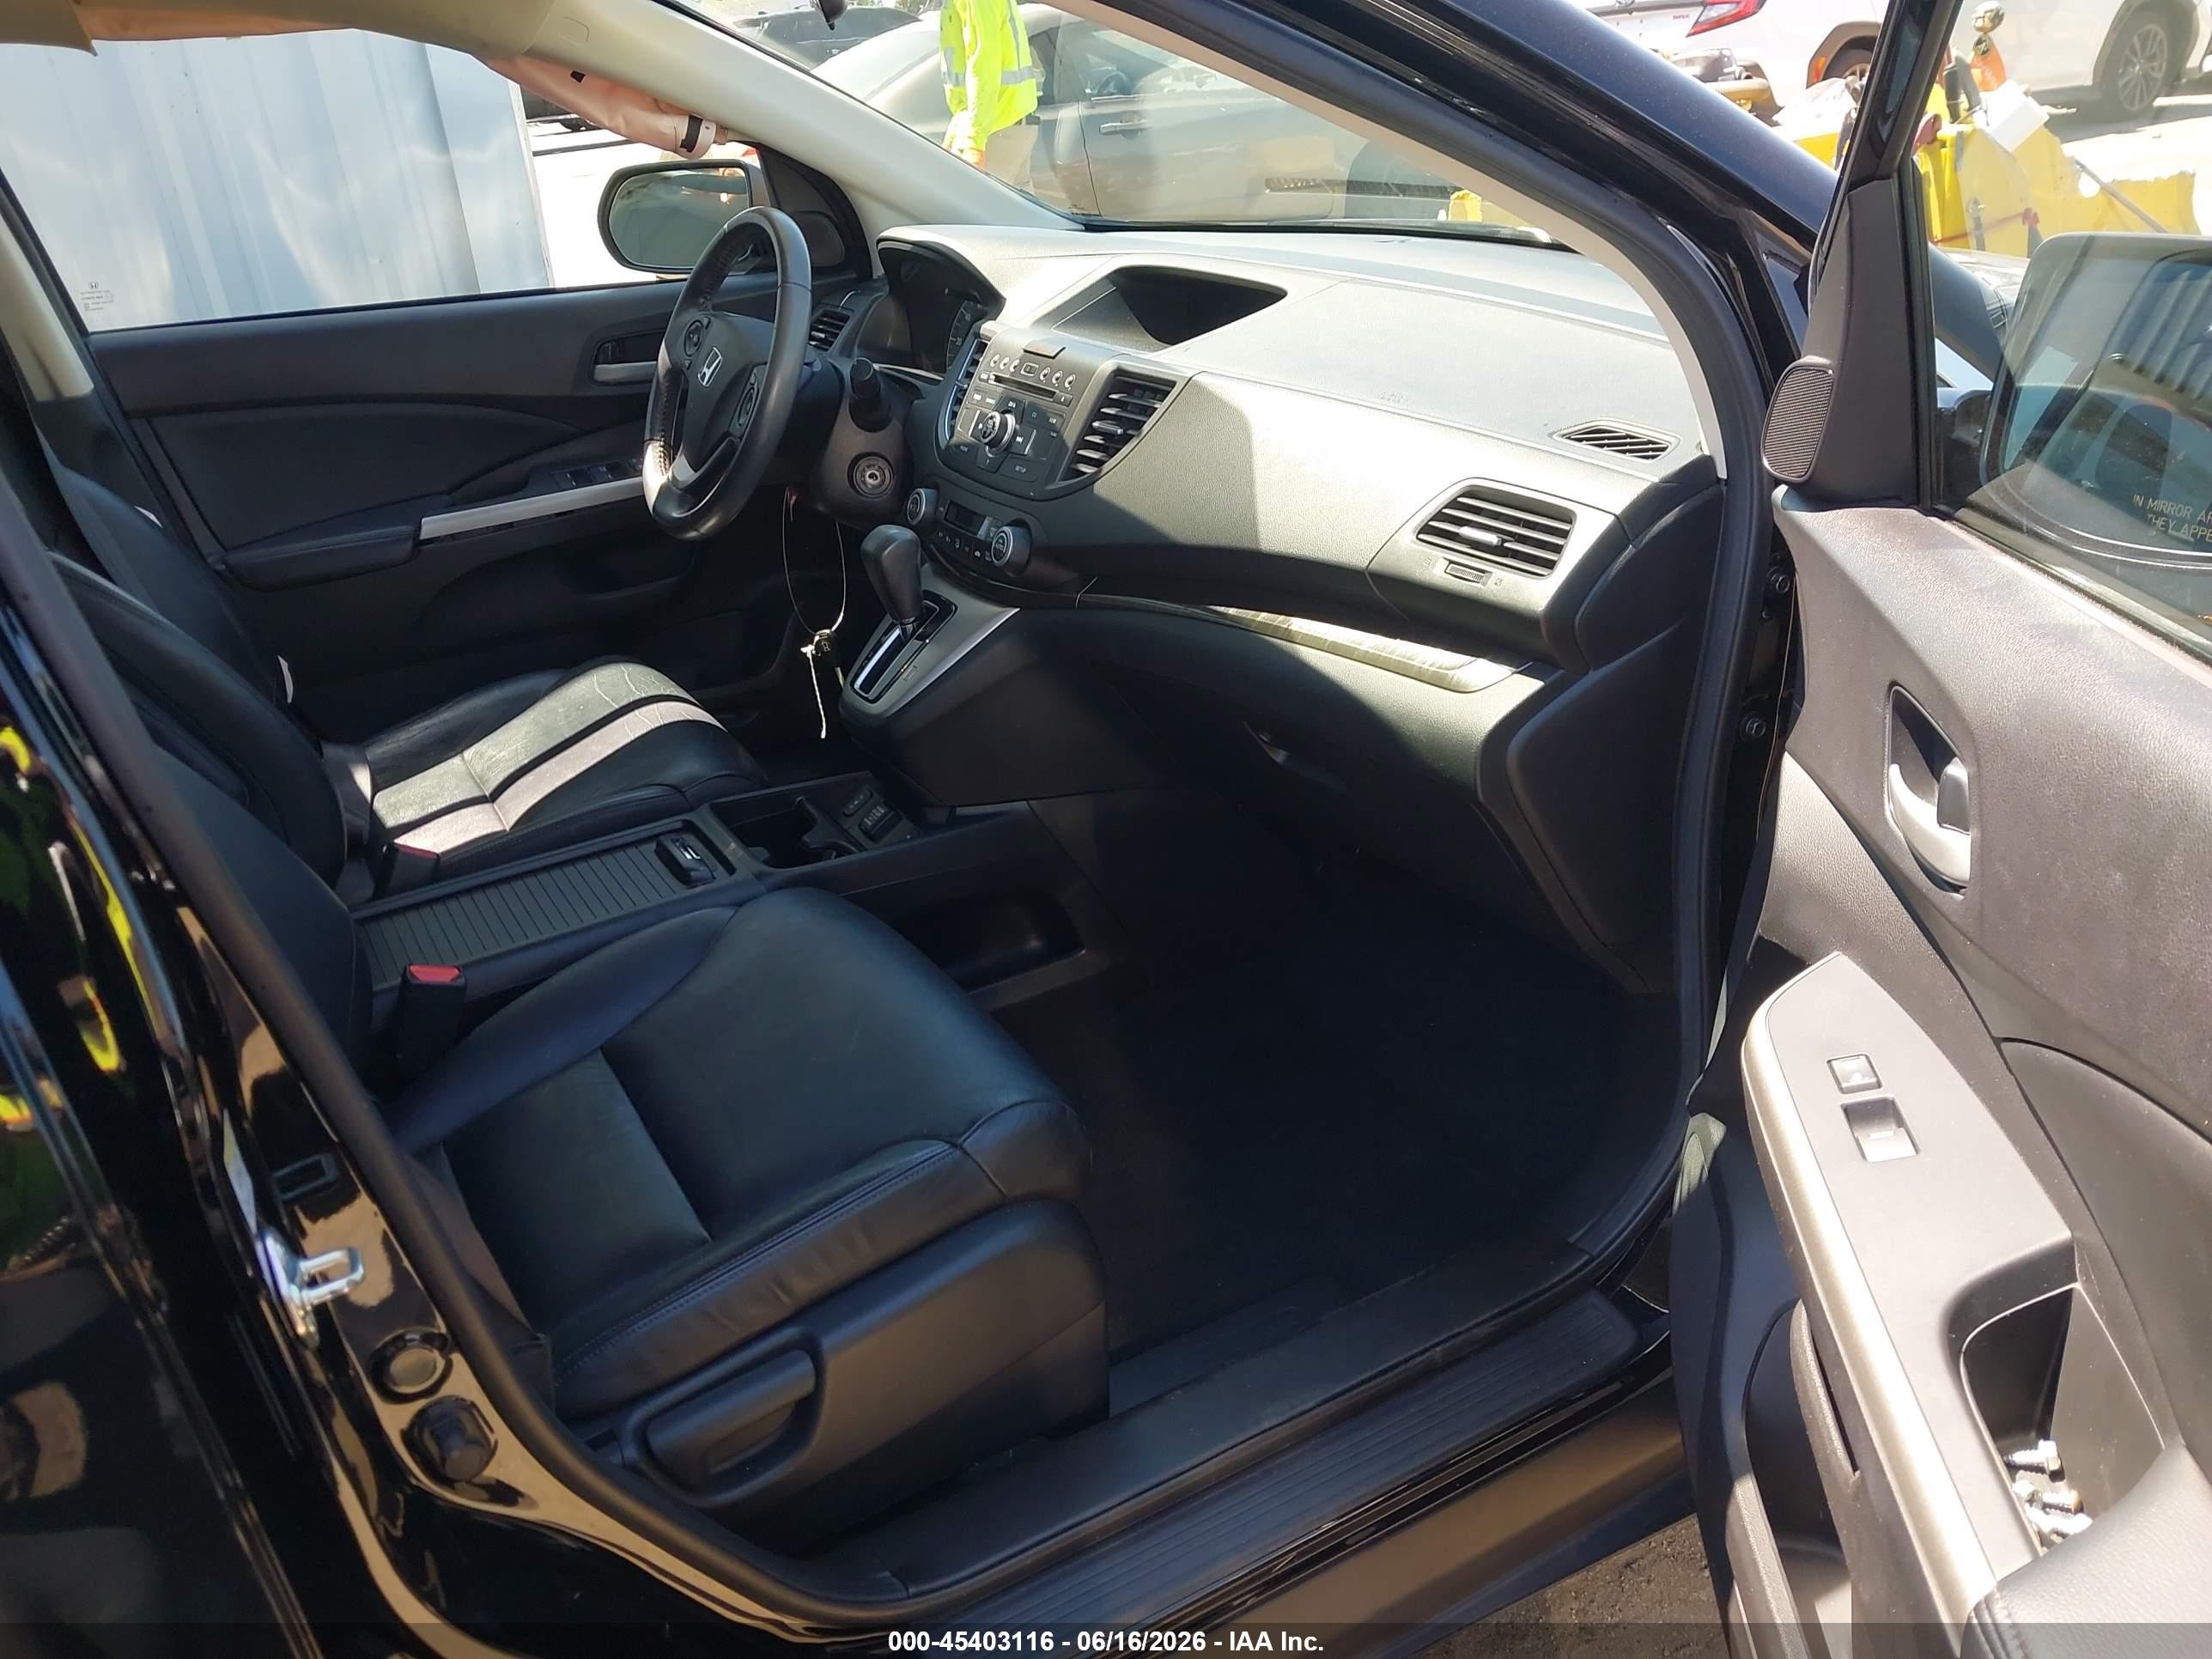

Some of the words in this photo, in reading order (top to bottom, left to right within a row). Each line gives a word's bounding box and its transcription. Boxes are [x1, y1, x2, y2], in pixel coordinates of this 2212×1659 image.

[2132, 494, 2145, 507] IN
[2147, 497, 2193, 520] MIRROR
[2147, 514, 2177, 532] THEY
